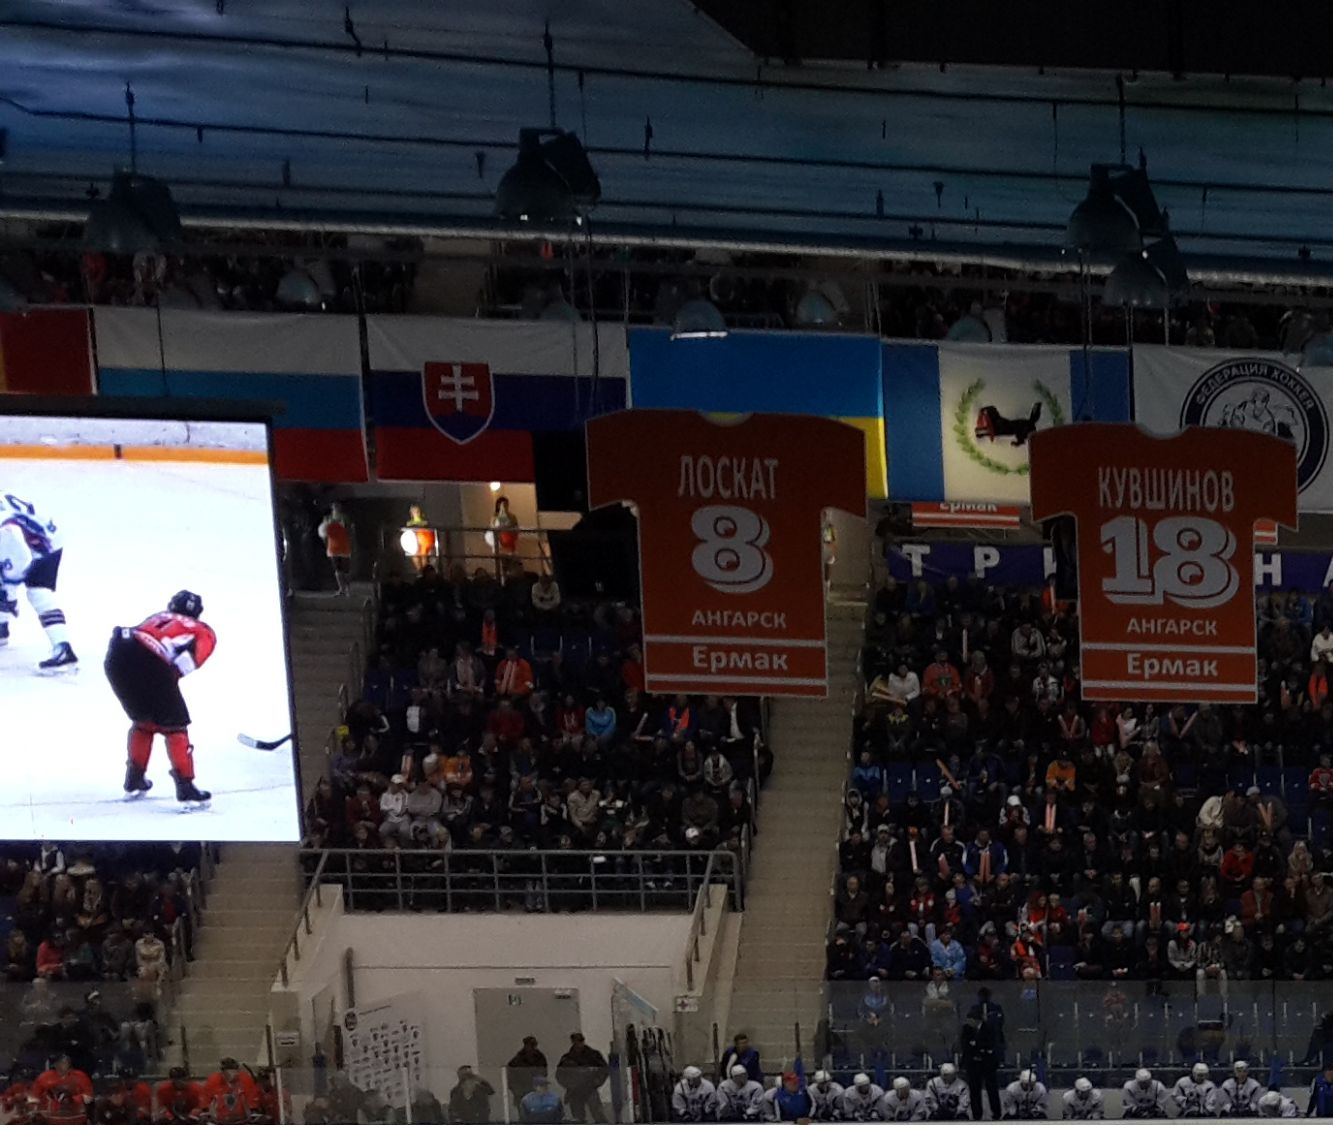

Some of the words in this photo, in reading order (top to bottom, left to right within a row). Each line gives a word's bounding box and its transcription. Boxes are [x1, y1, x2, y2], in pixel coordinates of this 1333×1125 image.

[1196, 363, 1269, 405] ФЕДЕРАЦИЯ
[1271, 368, 1315, 410] ХОККЕЯ
[678, 455, 779, 499] ЛОСКАТ
[1099, 467, 1236, 512] КУВШИНОВ
[691, 505, 774, 594] 8
[1101, 515, 1240, 609] 18
[692, 610, 787, 629] АНГАРСК
[1127, 618, 1218, 636] АНГАРСК
[692, 646, 789, 672] Ермак
[1127, 652, 1219, 679] Ермак
